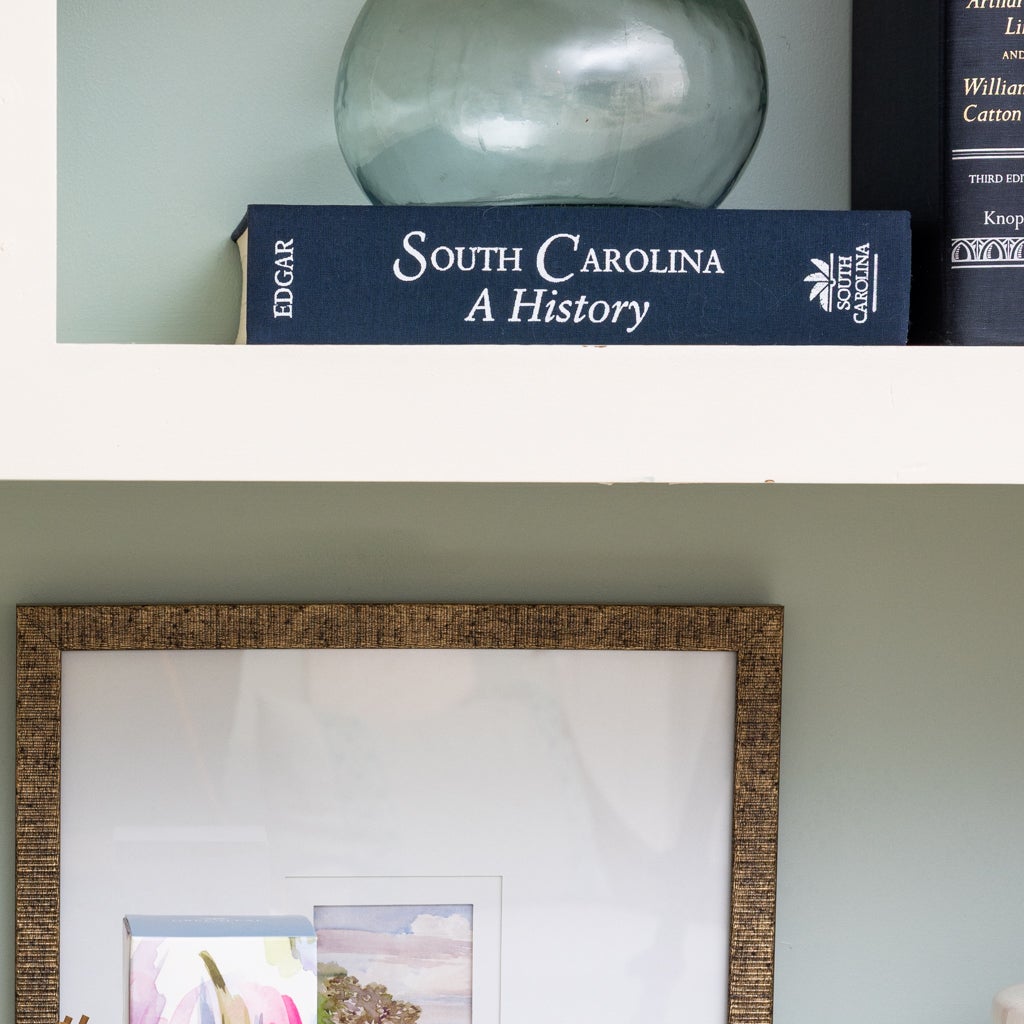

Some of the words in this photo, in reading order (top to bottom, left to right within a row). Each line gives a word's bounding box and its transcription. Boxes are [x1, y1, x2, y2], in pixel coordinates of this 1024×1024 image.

[1005, 16, 1024, 35] Li
[963, 103, 1022, 123] Catton
[968, 174, 1004, 184] THIRD
[273, 238, 294, 319] EDGAR
[392, 230, 524, 282] SOUTH
[536, 232, 726, 283] CAROLINA
[837, 255, 852, 311] SOUTH
[853, 242, 870, 324] CAROLINA
[464, 287, 495, 322] A
[507, 288, 650, 334] History
